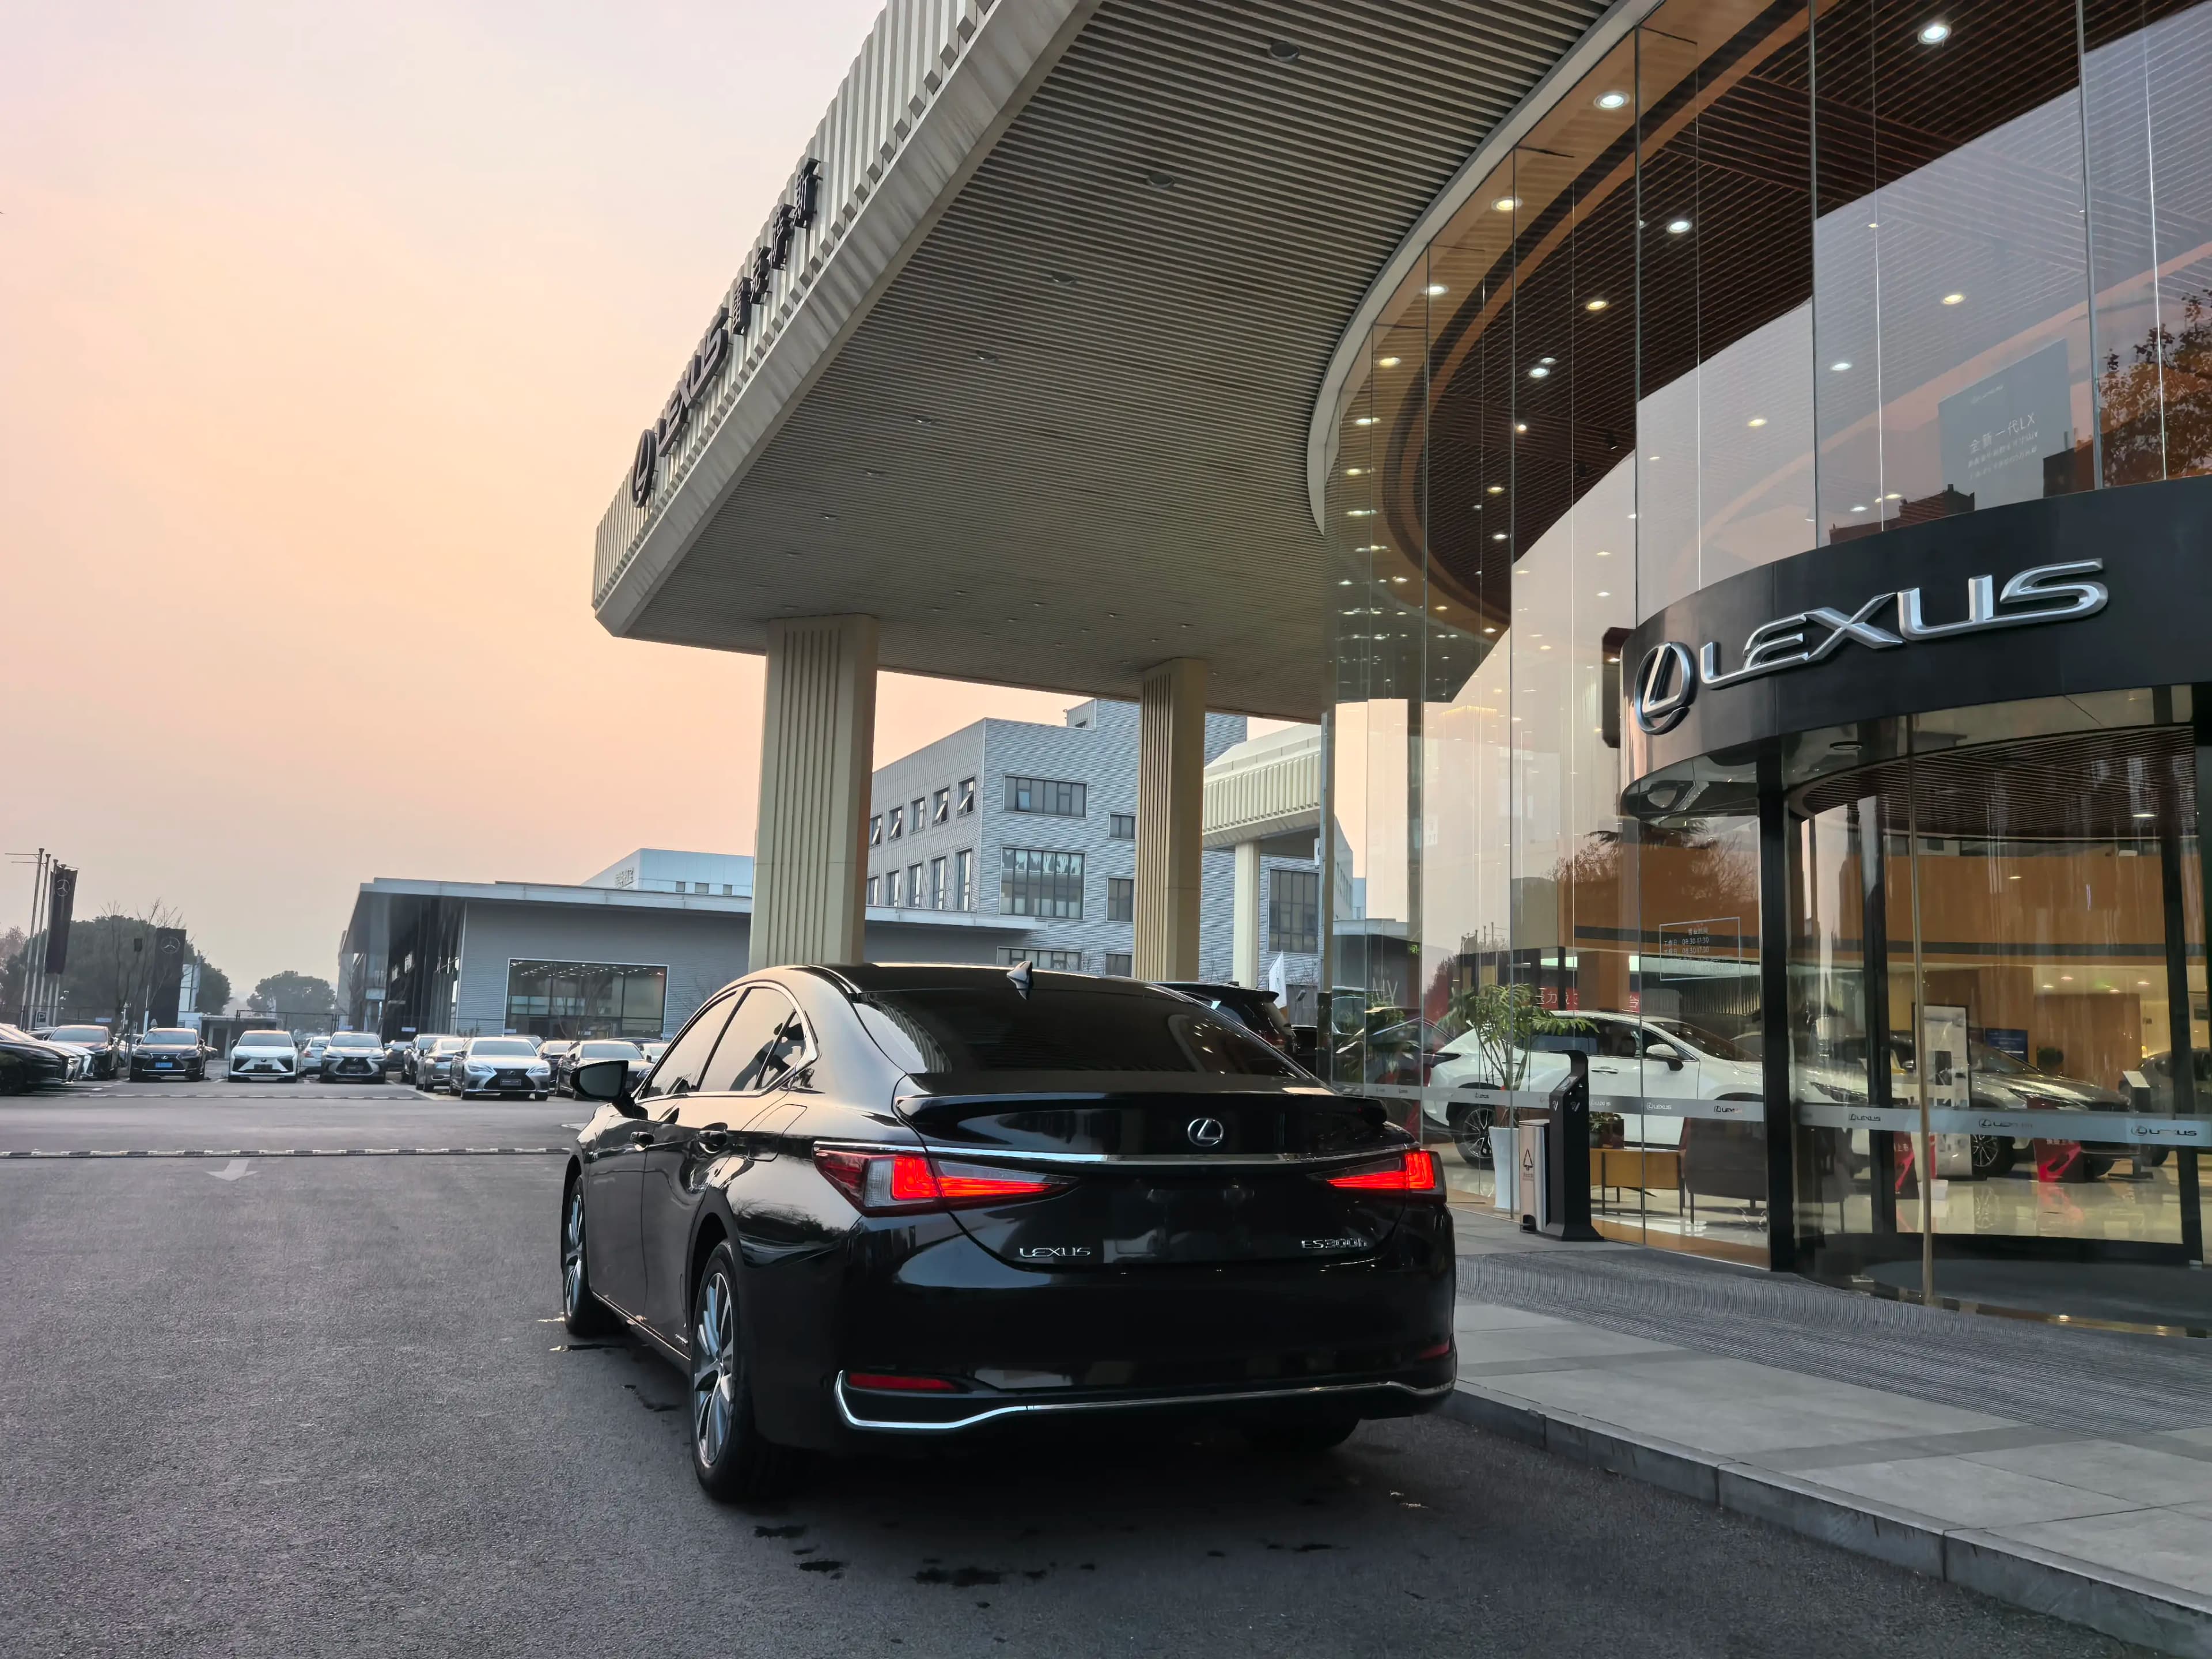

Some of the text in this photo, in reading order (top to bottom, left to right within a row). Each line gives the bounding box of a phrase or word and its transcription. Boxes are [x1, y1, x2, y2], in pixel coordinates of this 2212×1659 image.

[732, 157, 819, 335] 雷克萨斯
[657, 307, 729, 457] LEXUS
[1700, 558, 2109, 691] LEXUS
[1019, 1247, 1092, 1257] LEXUS
